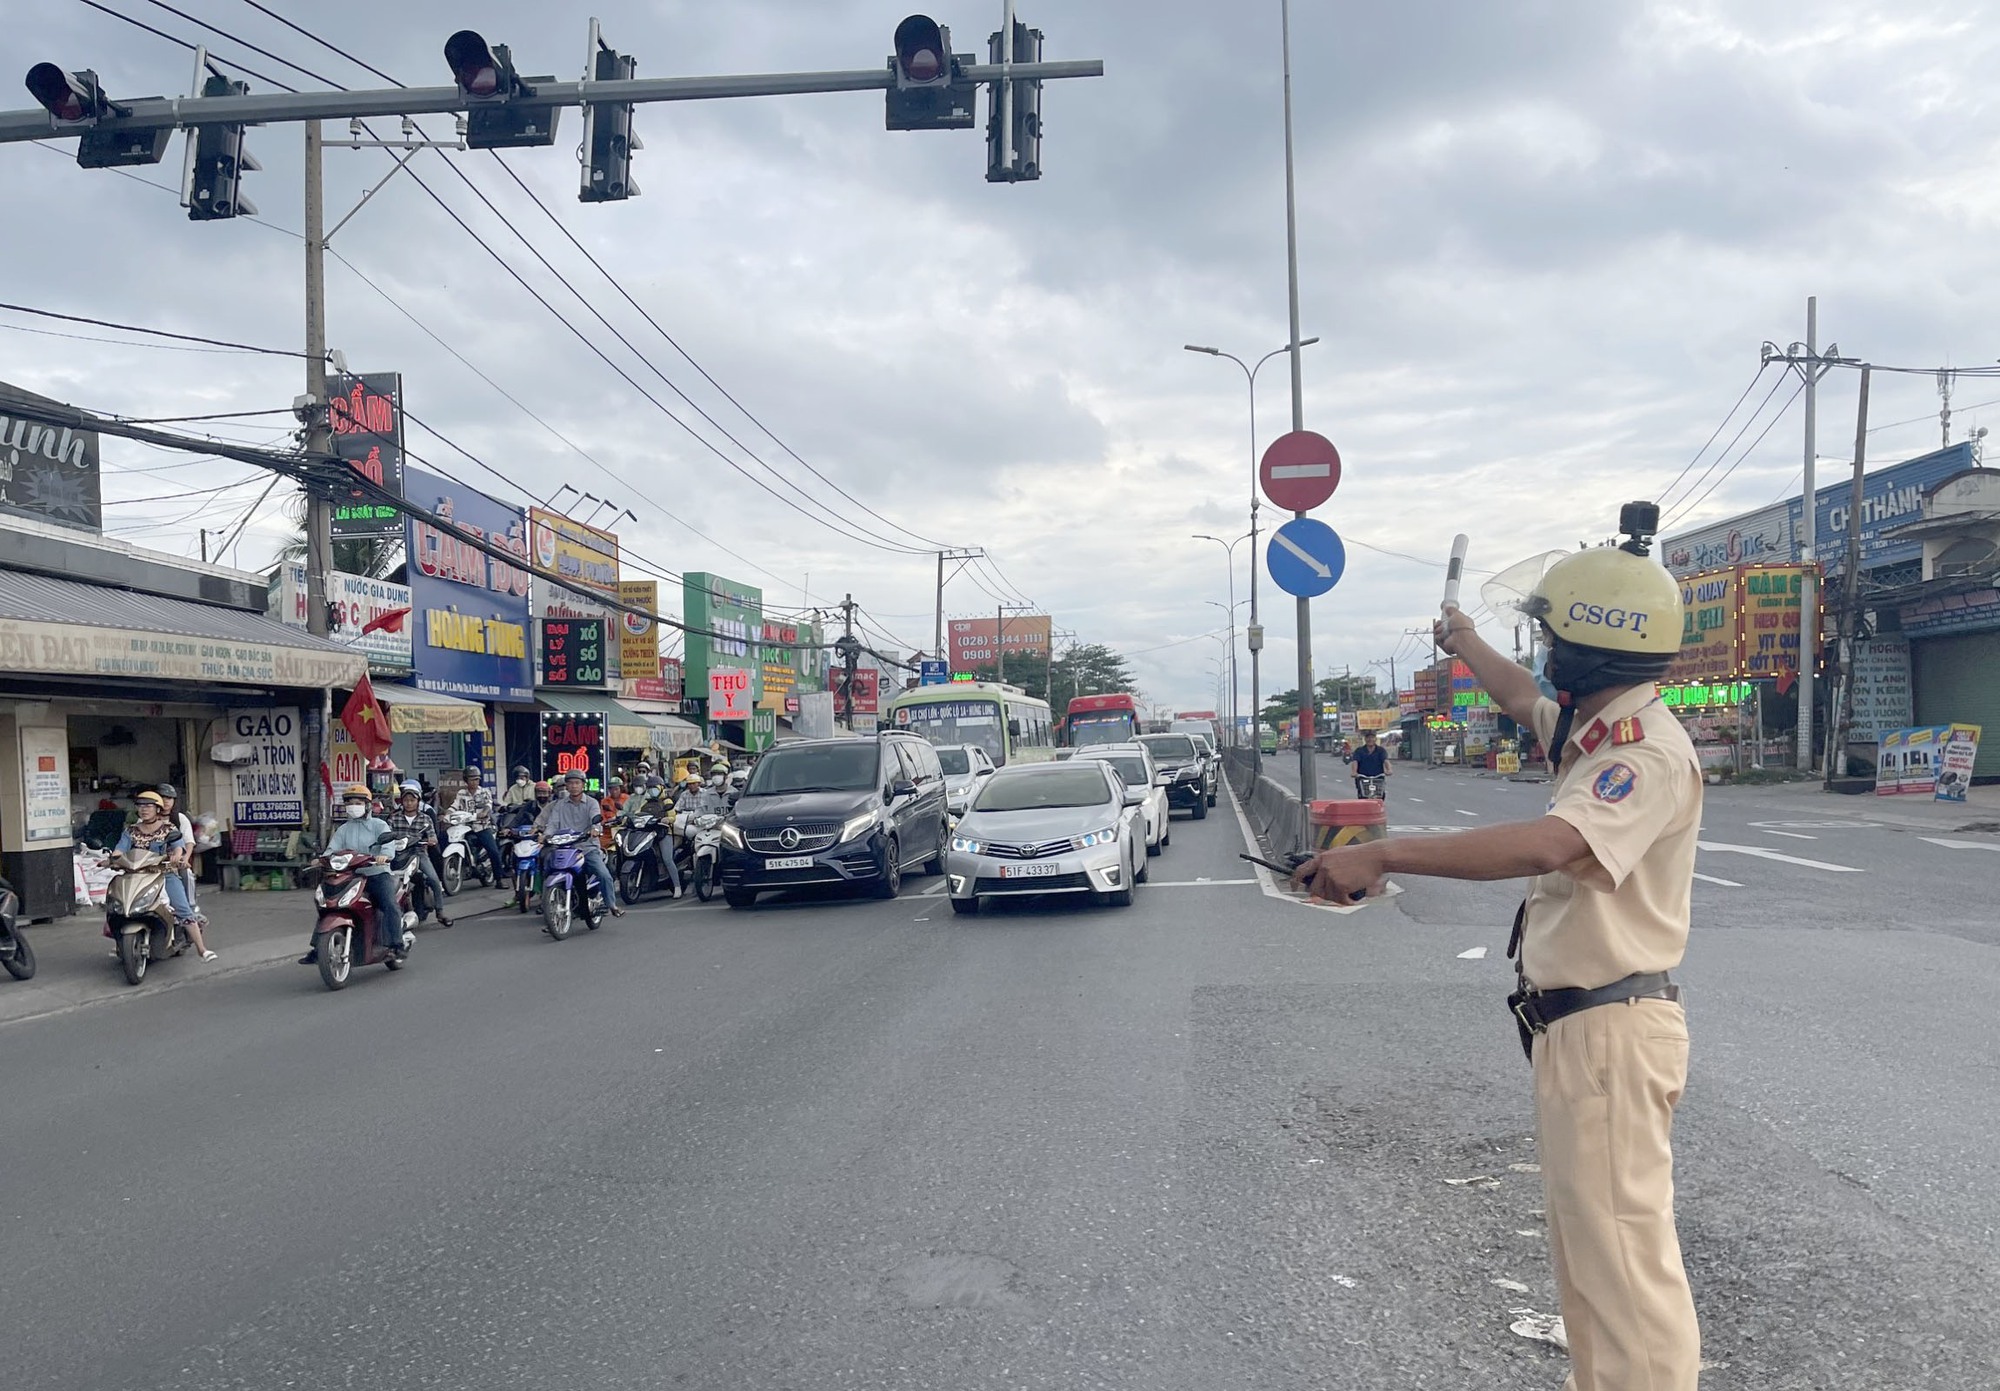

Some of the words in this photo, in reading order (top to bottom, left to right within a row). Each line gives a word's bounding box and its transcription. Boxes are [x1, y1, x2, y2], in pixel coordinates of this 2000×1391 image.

[344, 577, 369, 596] NƯỚC
[370, 584, 385, 600] GIA
[1696, 579, 1728, 603] QUAY
[1747, 571, 1788, 595] NĂM
[1568, 601, 1648, 633] CSGT
[1753, 612, 1779, 629] HEO
[426, 604, 484, 653] HOÀNG
[485, 613, 525, 658] TÙNG
[958, 635, 989, 648] (028)
[1024, 633, 1042, 643] 1111
[580, 644, 597, 662] SỐ
[963, 649, 991, 660] 0908
[576, 664, 601, 682] CÀO
[711, 669, 747, 691] THÚ
[724, 691, 736, 708] Y
[1683, 685, 1709, 706] QUAY
[898, 709, 908, 724] 9
[235, 714, 292, 743] GẠO
[264, 740, 295, 766] TRÒN
